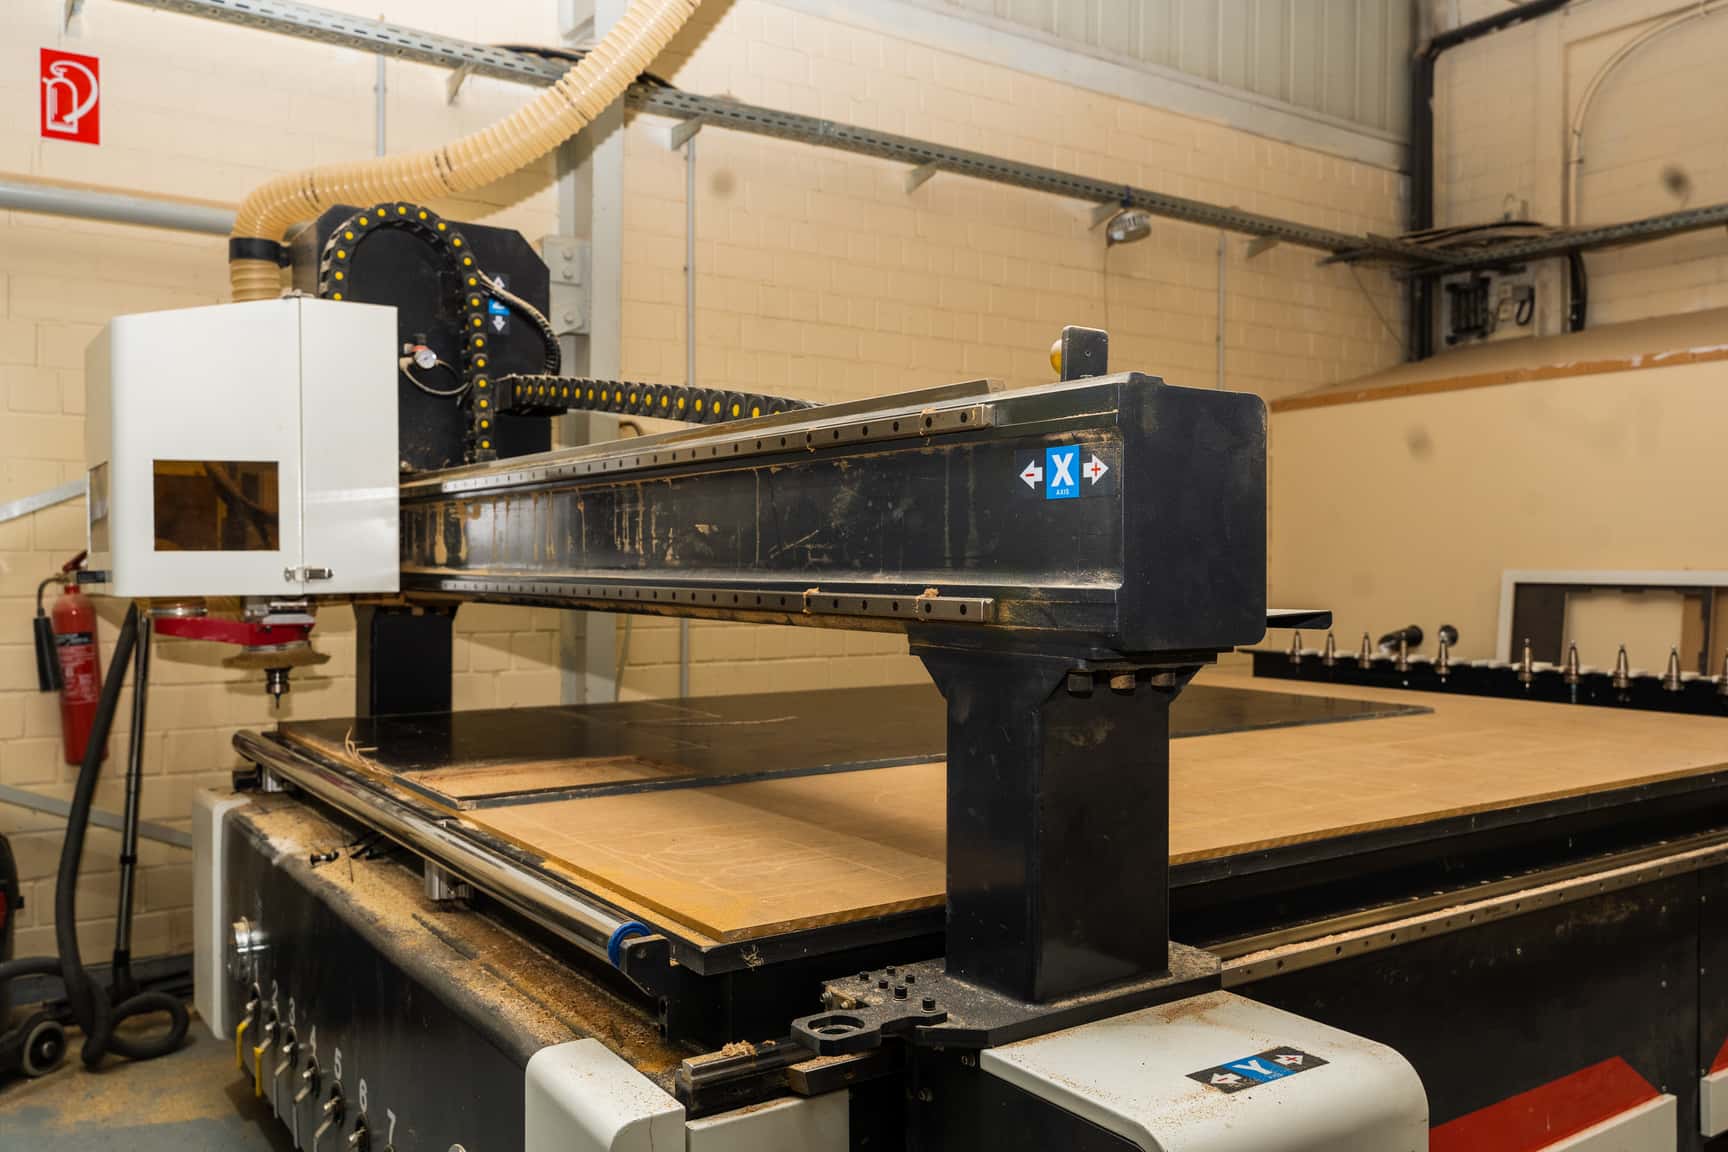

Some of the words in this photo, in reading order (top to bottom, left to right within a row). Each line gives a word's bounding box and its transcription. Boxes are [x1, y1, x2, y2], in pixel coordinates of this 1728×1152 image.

[1050, 453, 1074, 487] X
[1232, 1060, 1273, 1075] Y
[386, 1108, 396, 1145] 7
